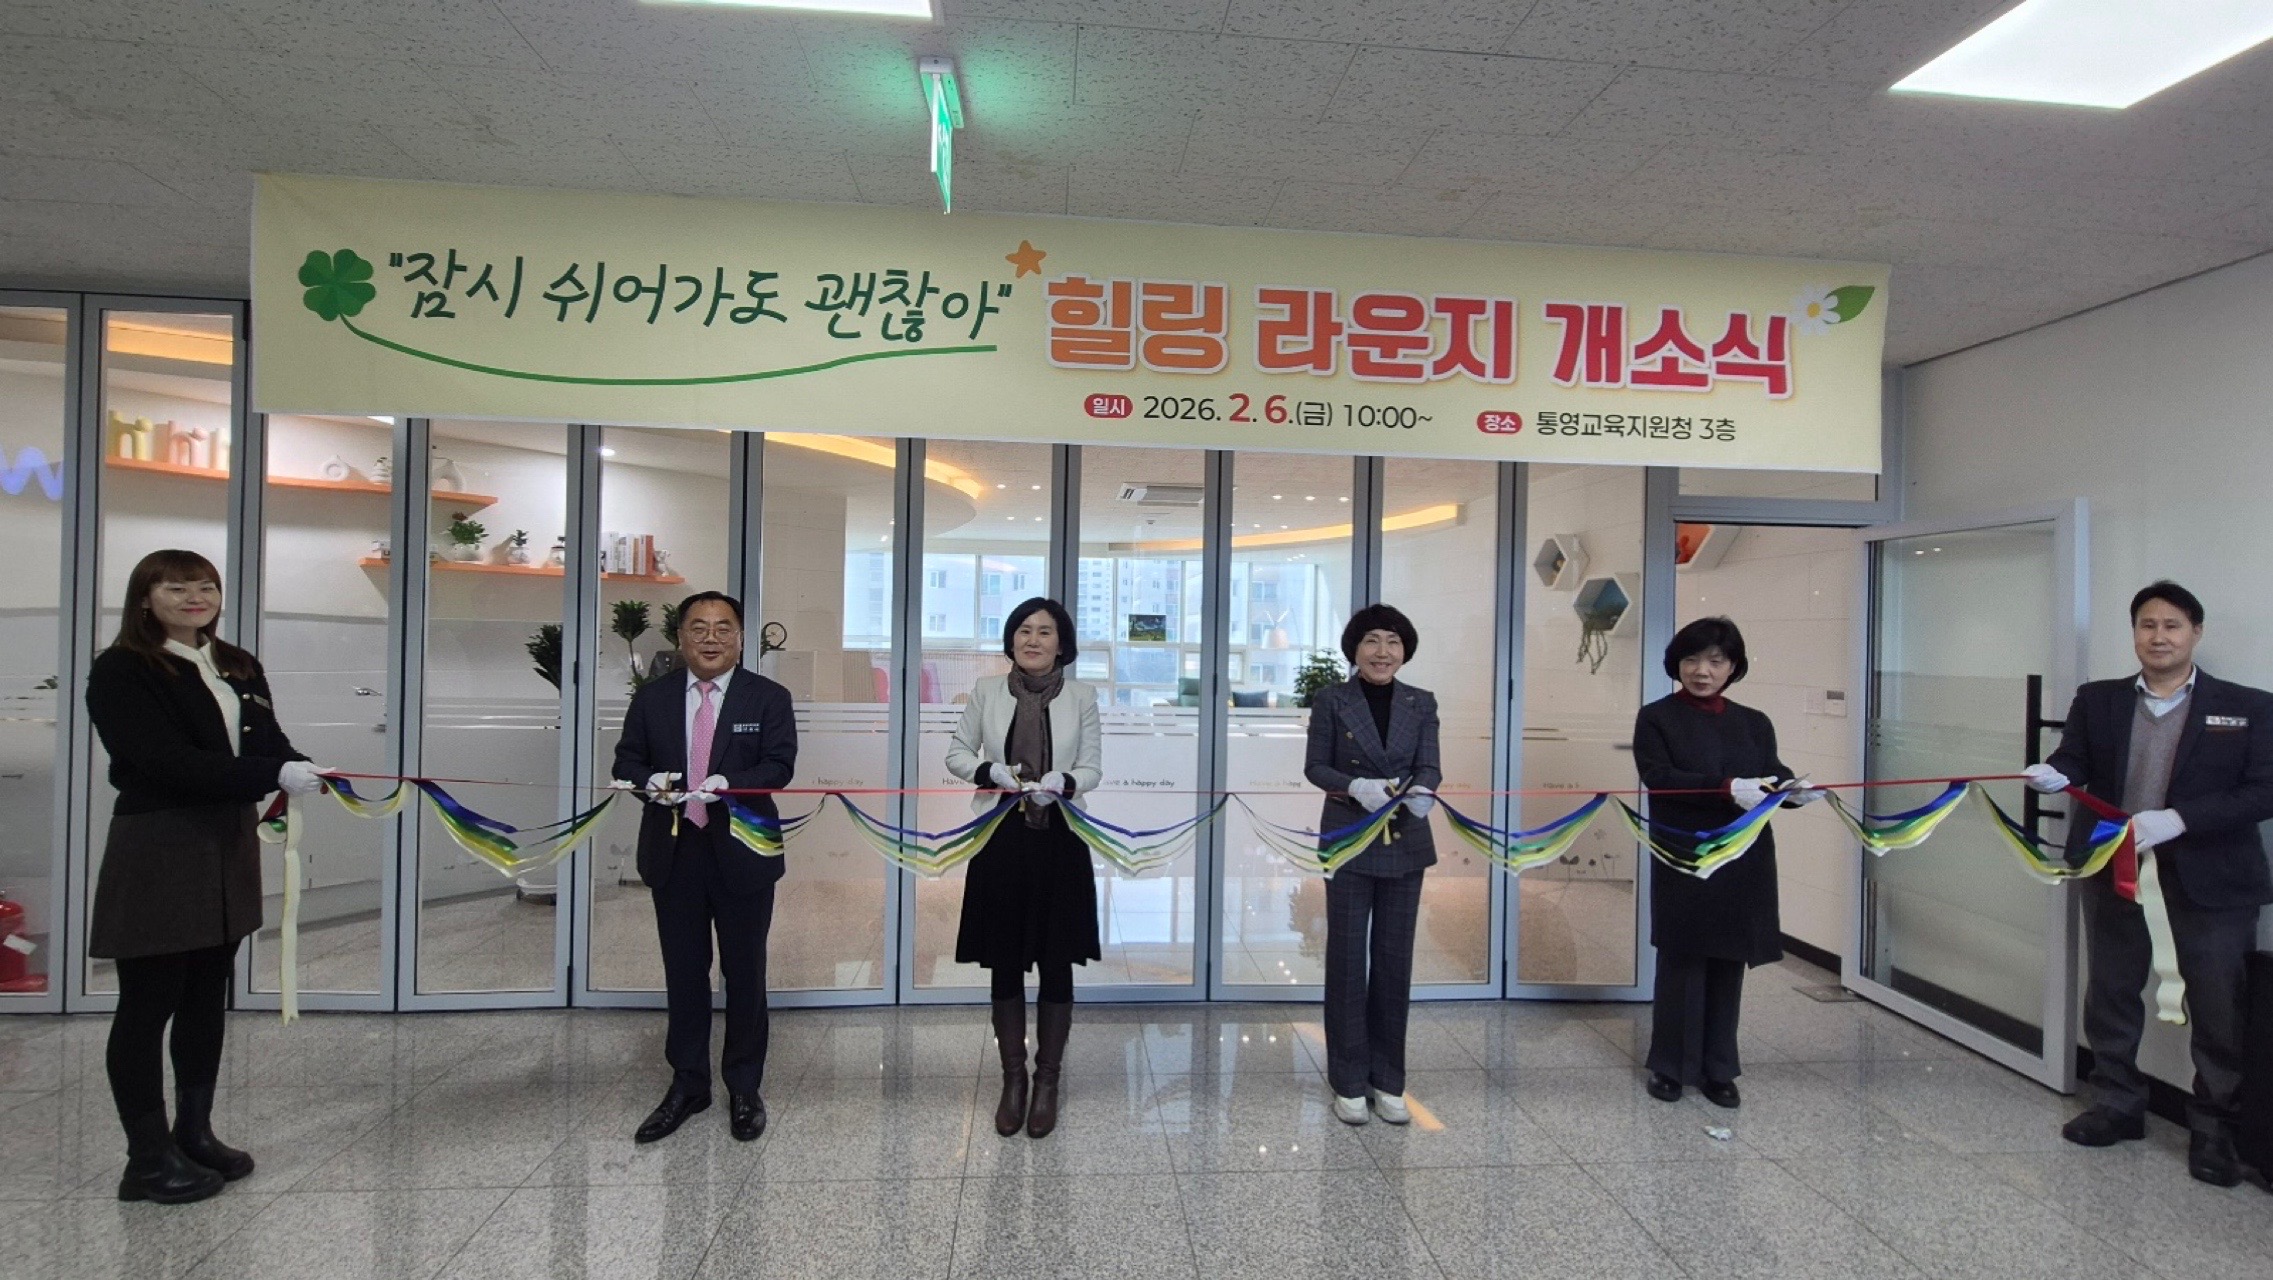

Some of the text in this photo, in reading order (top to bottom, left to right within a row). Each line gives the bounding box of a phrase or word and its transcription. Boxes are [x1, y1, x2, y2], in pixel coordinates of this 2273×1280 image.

[542, 262, 788, 328] 쉬어가도
[1046, 276, 1789, 395] 힐링 라운지 개소식
[1092, 397, 1126, 416] 일시
[1143, 395, 1222, 422] 2026.
[1343, 404, 1434, 430] 10:00~
[1483, 411, 1737, 441] 장소 통영교육지원청 3층
[1131, 778, 1157, 788] happy
[1159, 779, 1175, 789] day
